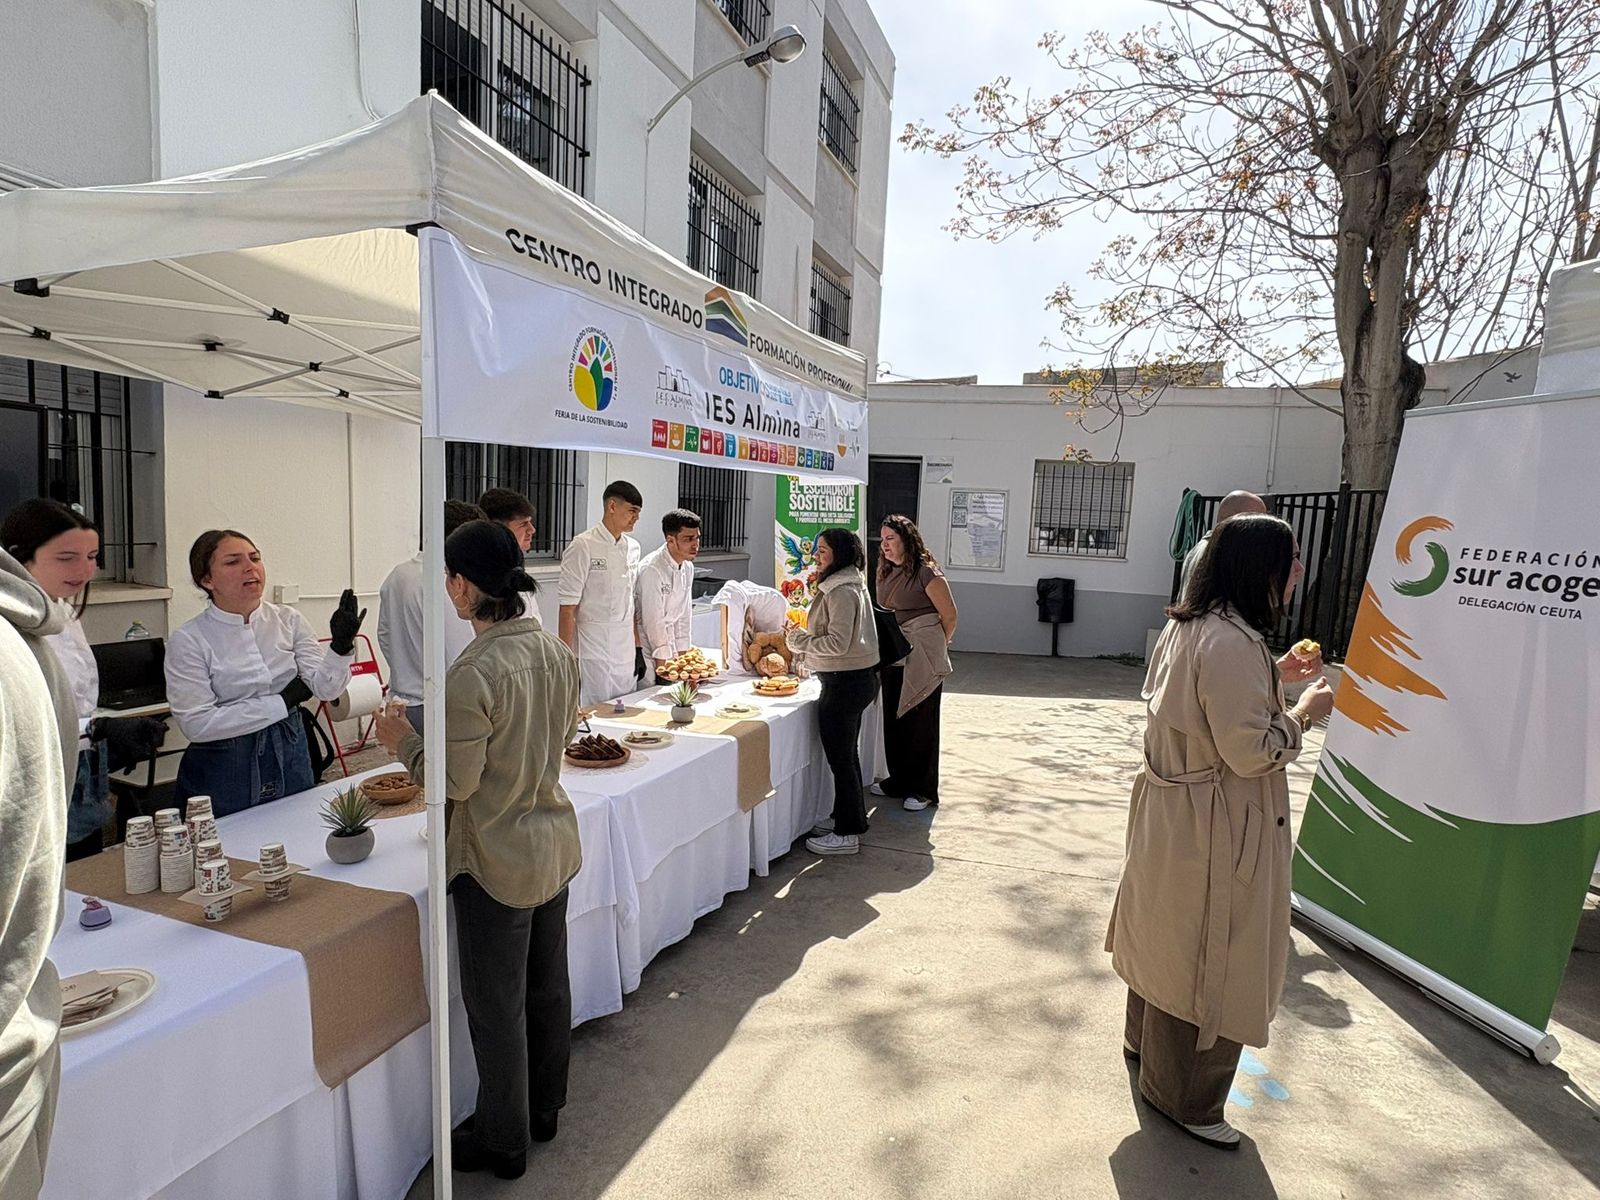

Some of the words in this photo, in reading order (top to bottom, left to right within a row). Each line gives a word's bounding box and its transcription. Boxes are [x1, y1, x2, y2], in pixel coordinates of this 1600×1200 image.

[505, 228, 601, 285] CENTRO
[608, 269, 703, 329] INTEGRADO
[749, 332, 806, 373] FORMACIÓN
[554, 409, 570, 419] FERIA
[571, 412, 578, 421] DE
[579, 414, 586, 422] LA
[586, 415, 629, 429] SOSTENIBILIDAD
[704, 391, 736, 426] IES
[742, 403, 800, 438] Almina
[790, 480, 801, 494] EL
[789, 493, 856, 512] SOSTENIBLE
[1460, 547, 1600, 569] FEDERACIÓN
[1453, 566, 1501, 587] sur
[1506, 570, 1600, 603] acoge
[1458, 595, 1536, 615] DELEGACIÓN
[1539, 604, 1583, 621] CEUTA
